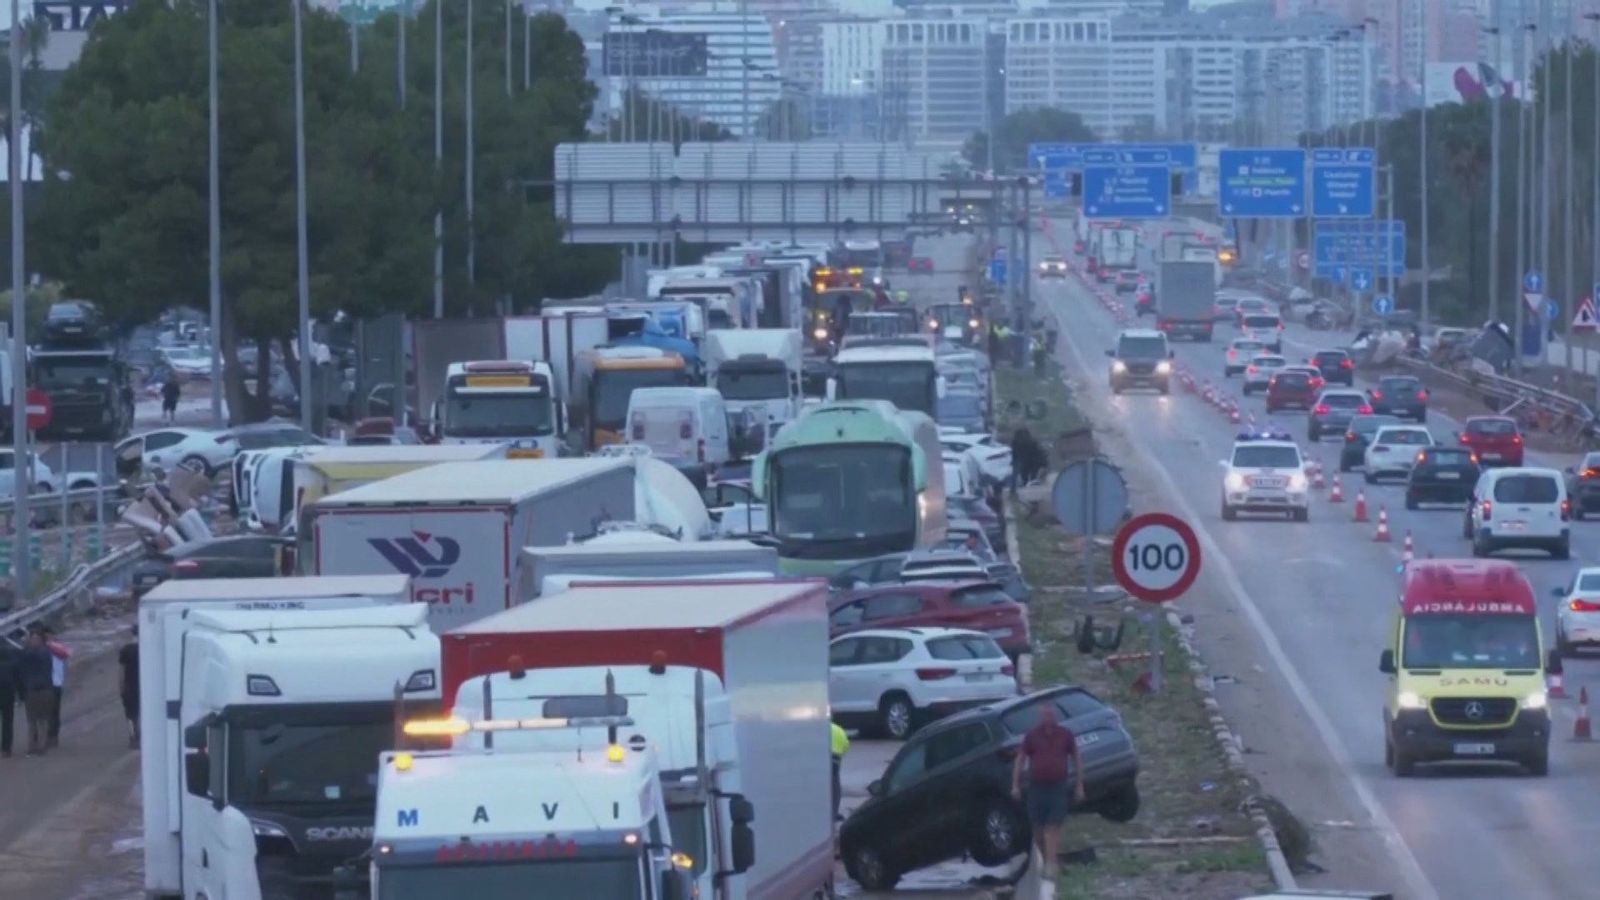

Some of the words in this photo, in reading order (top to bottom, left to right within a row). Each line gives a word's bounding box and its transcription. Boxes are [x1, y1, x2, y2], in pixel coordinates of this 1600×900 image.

[1129, 543, 1184, 571] 100
[1439, 677, 1508, 687] SAMU
[306, 825, 374, 841] SCAN
